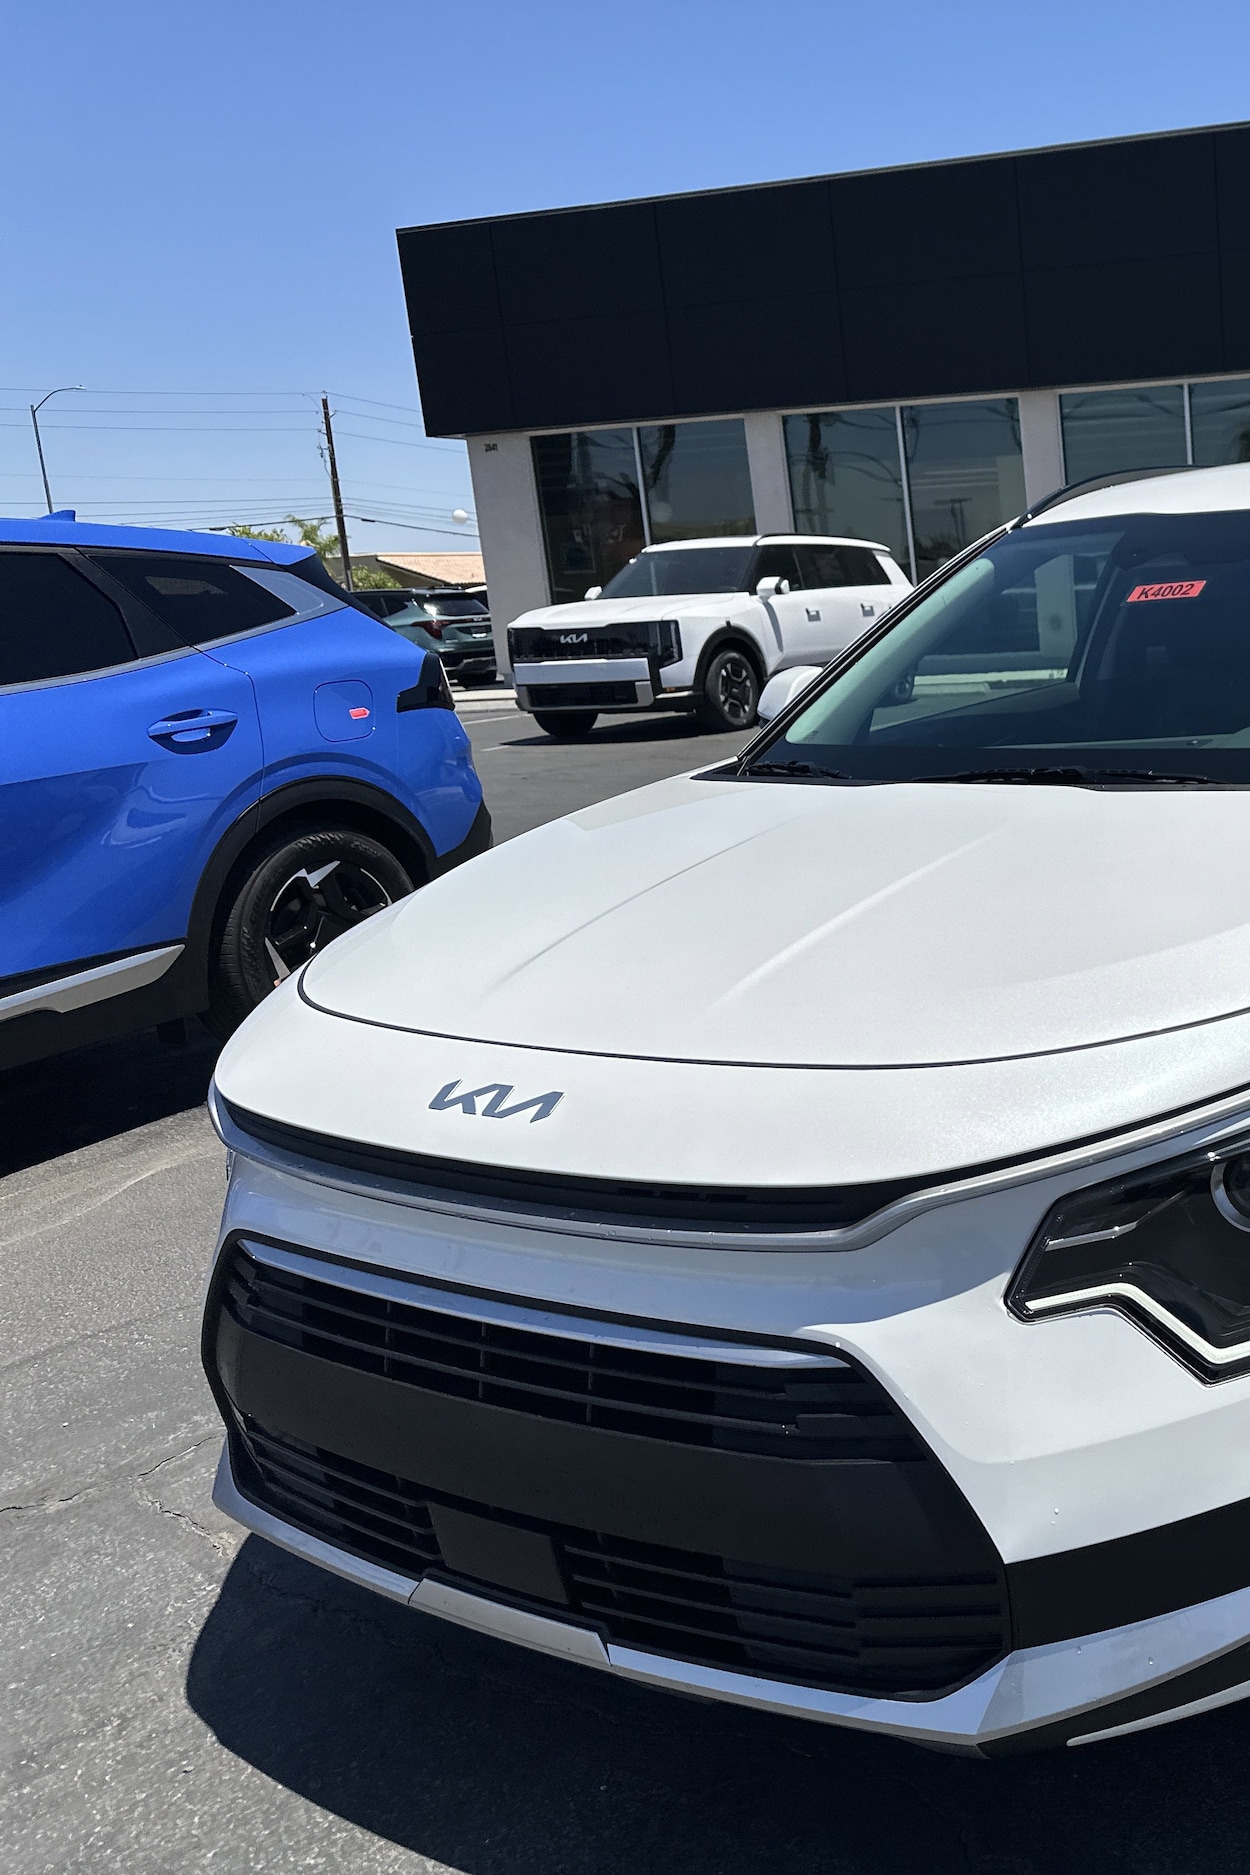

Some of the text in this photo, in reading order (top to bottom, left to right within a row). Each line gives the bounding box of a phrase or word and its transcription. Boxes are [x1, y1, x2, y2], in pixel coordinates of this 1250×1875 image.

[1137, 583, 1195, 599] K4002
[560, 633, 588, 644] KIA
[428, 1078, 565, 1124] KIA
